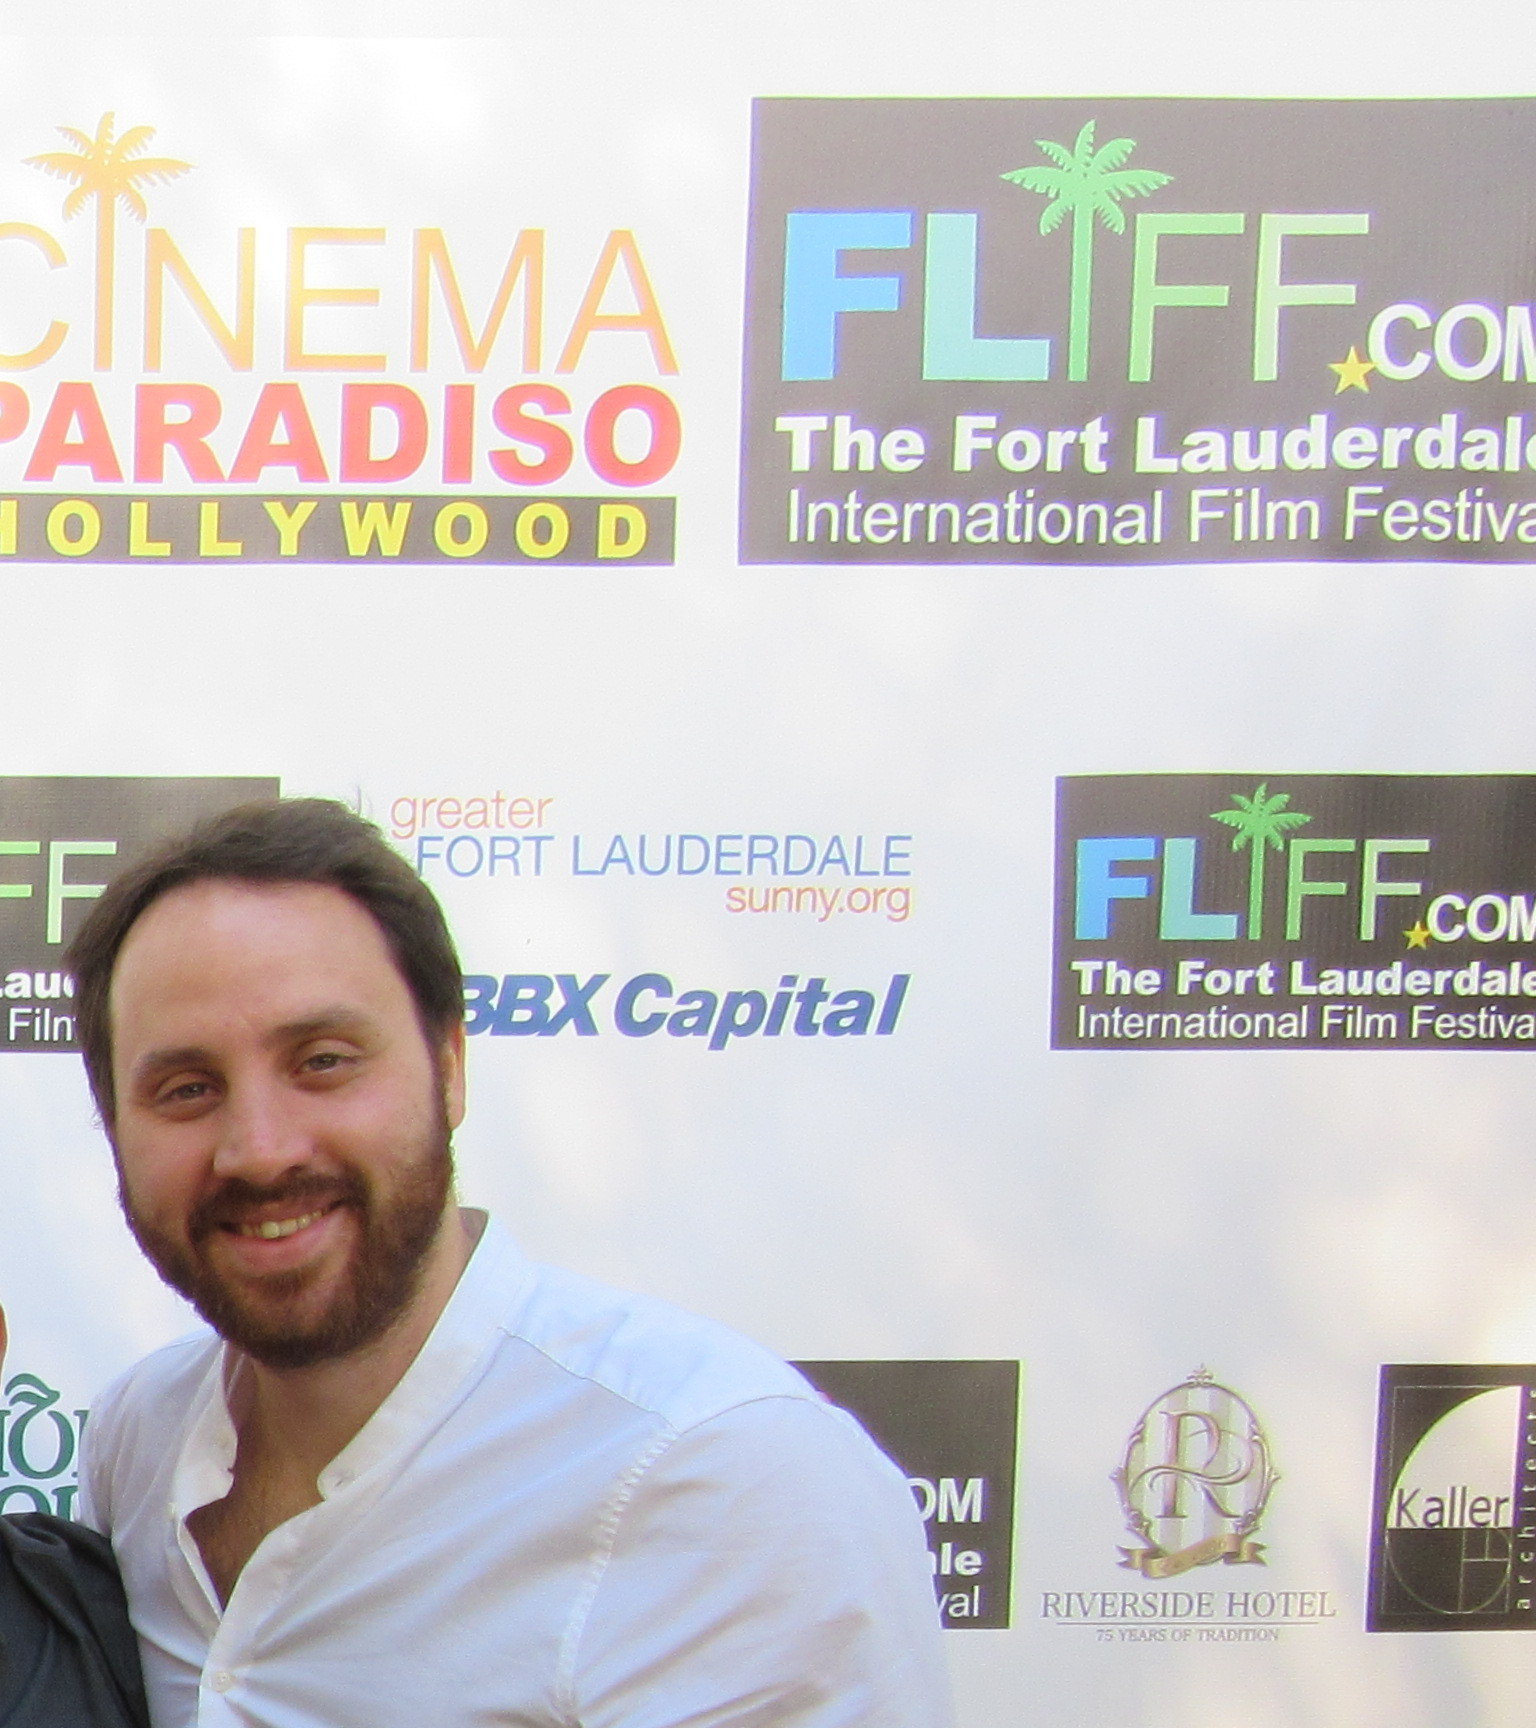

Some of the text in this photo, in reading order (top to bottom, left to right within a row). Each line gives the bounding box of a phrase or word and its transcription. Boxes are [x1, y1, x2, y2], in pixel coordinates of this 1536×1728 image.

[776, 415, 926, 473] The
[952, 414, 1109, 473] Fort
[786, 488, 1320, 544] International Film
[391, 790, 554, 839] greater
[416, 834, 912, 878] FORT LAUDERDALE
[726, 885, 911, 922] sunny.org
[1070, 960, 1161, 996] The
[1177, 960, 1275, 996] Fort
[614, 973, 911, 1051] Capital
[1077, 1004, 1307, 1040] International
[1322, 1005, 1396, 1039] Film
[1395, 1486, 1509, 1528] Kaller
[1041, 1592, 1337, 1619] RIVERSIDE HOTEL
